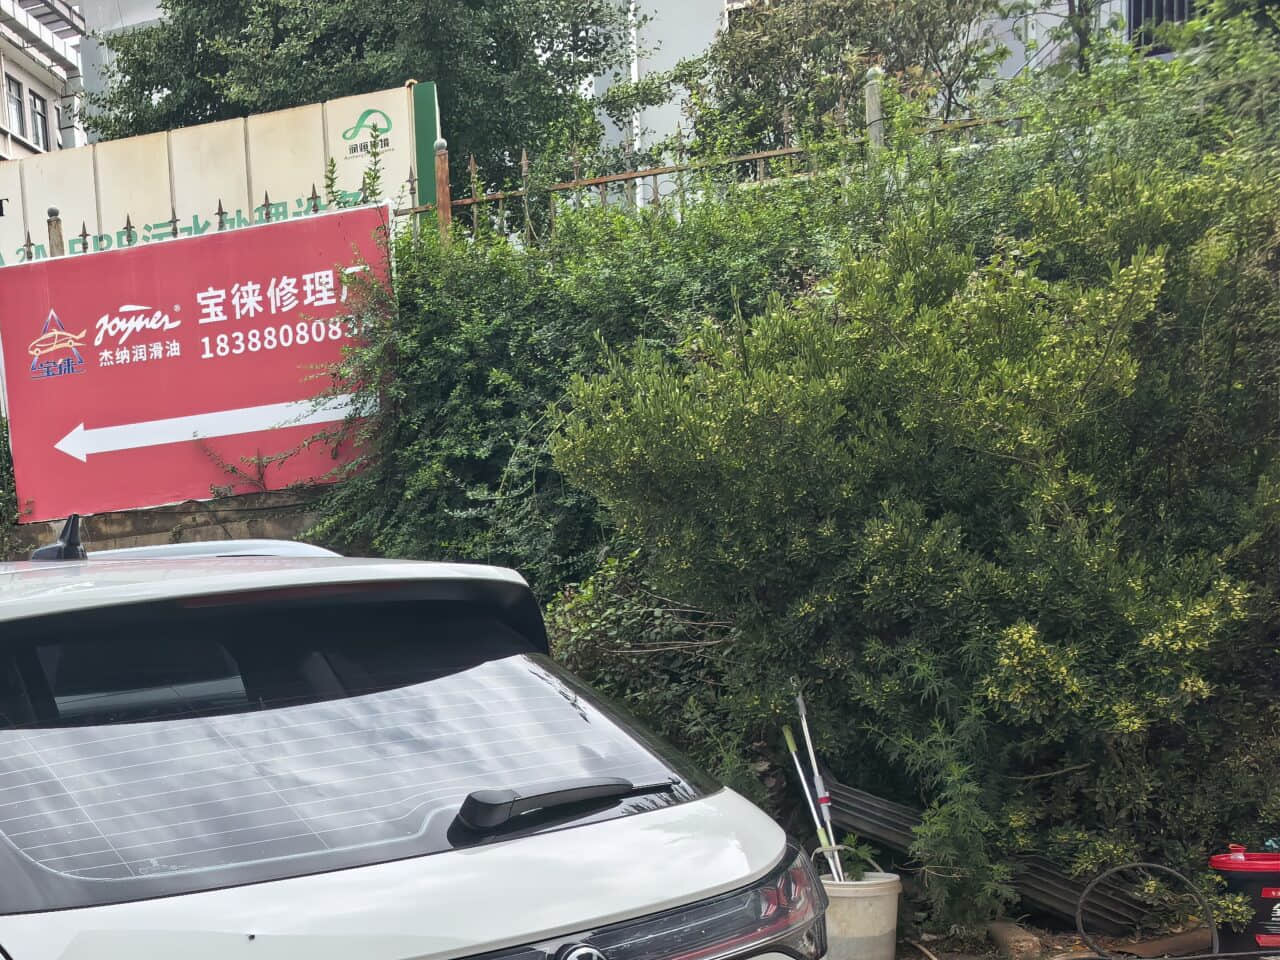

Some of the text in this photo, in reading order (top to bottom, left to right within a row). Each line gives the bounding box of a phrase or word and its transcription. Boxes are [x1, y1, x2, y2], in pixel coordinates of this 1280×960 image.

[99, 340, 181, 367] 杰纳润滑油
[200, 314, 370, 359] 1838808083
